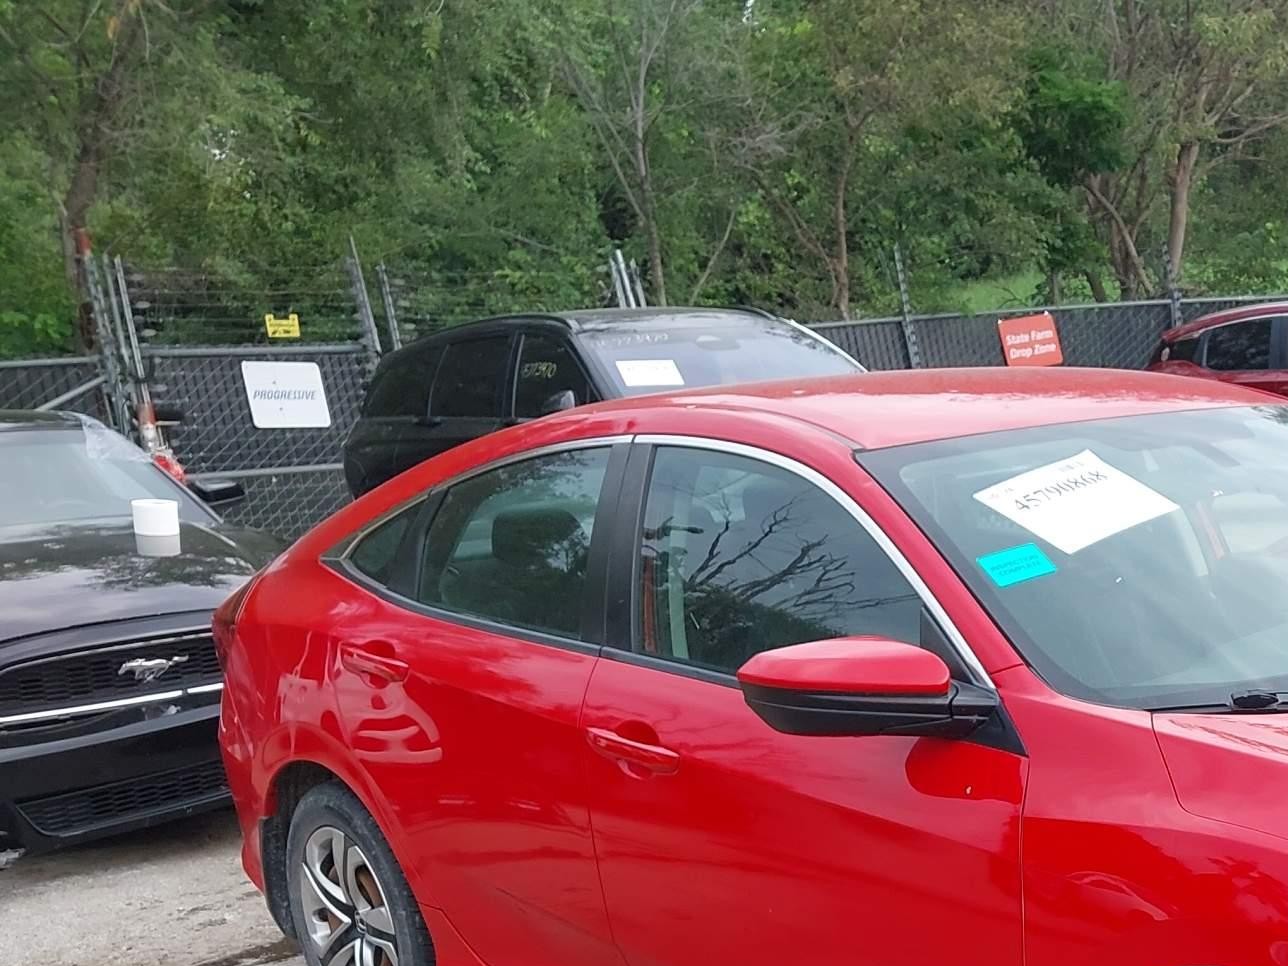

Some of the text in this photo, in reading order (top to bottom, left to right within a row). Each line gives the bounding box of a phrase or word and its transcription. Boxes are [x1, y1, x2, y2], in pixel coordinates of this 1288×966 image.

[1006, 330, 1054, 345] State Farm
[1010, 344, 1057, 359] Drop Zone
[253, 390, 317, 401] PROGRESSIVE
[1014, 469, 1108, 511] 45790868
